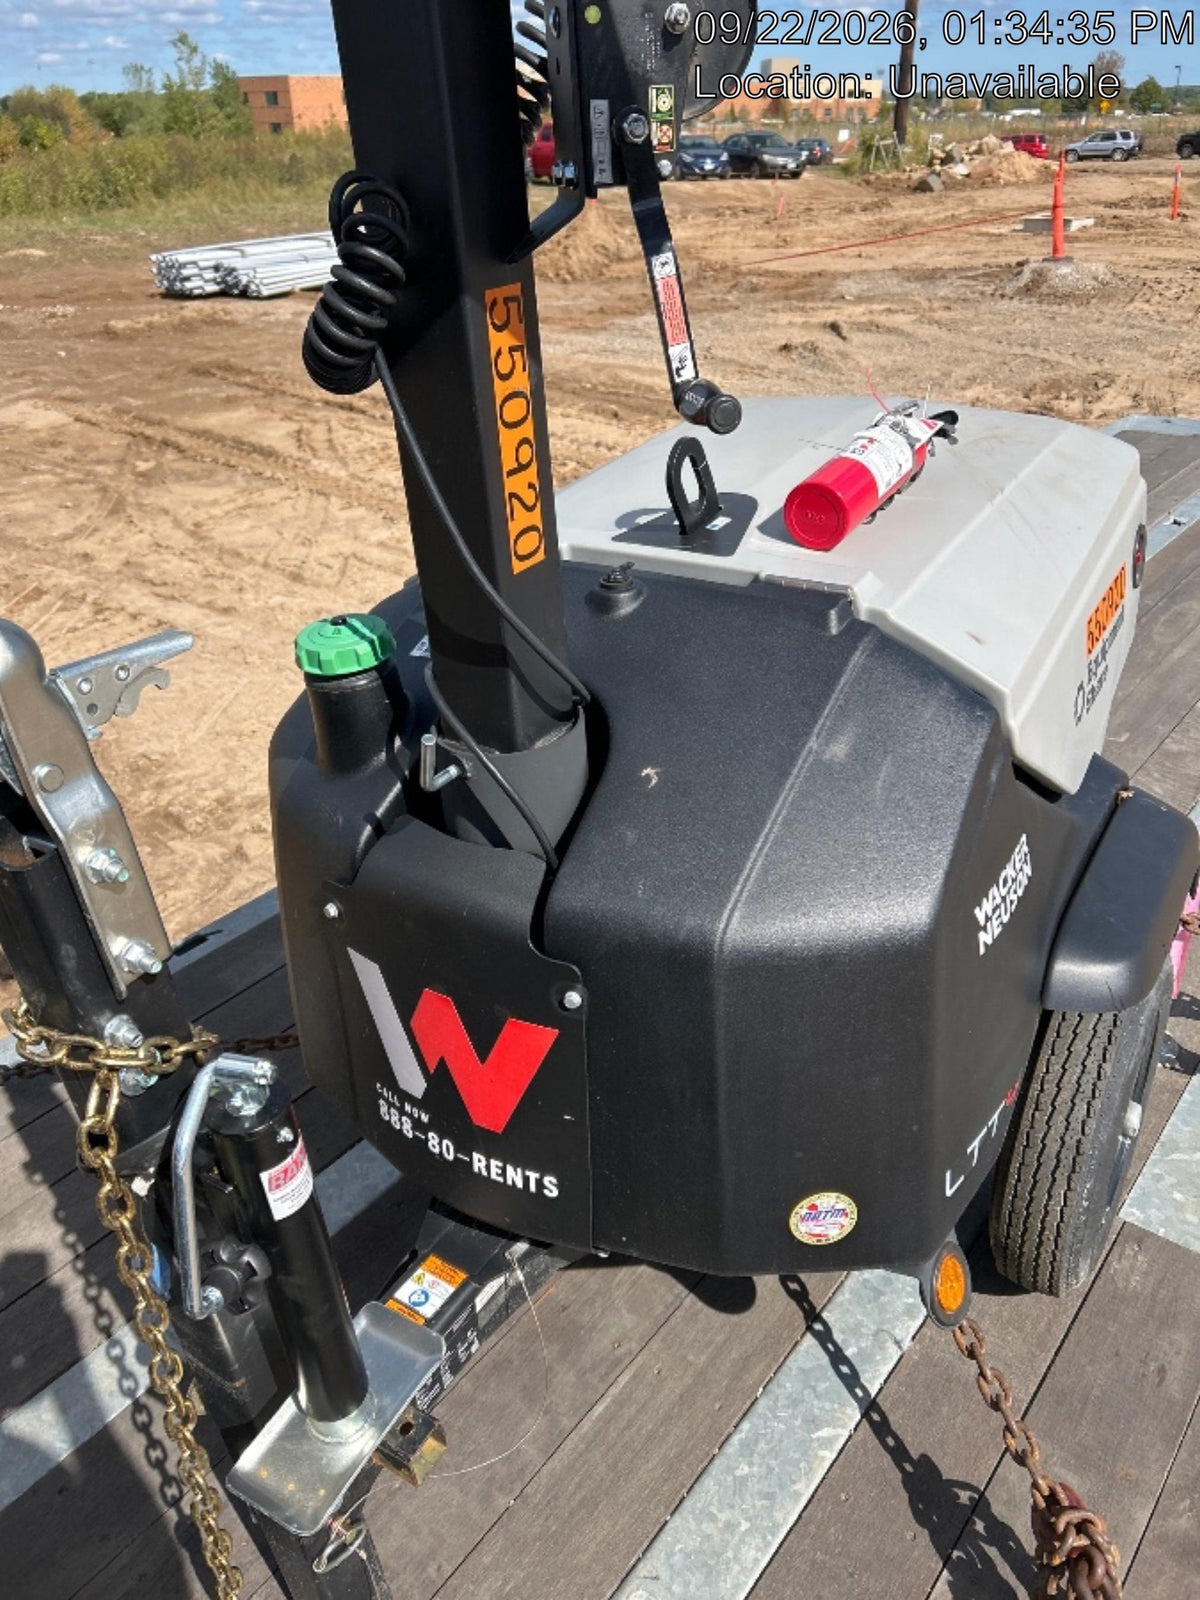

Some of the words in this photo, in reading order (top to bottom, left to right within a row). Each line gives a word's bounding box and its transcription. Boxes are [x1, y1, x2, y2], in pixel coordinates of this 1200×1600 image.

[488, 295, 543, 562] 550920
[974, 833, 1029, 927] WACKER
[978, 853, 1032, 956] NEUSON
[376, 1082, 401, 1107] CALL
[404, 1101, 430, 1124] NOW
[378, 1098, 560, 1198] 888-80-RENTS
